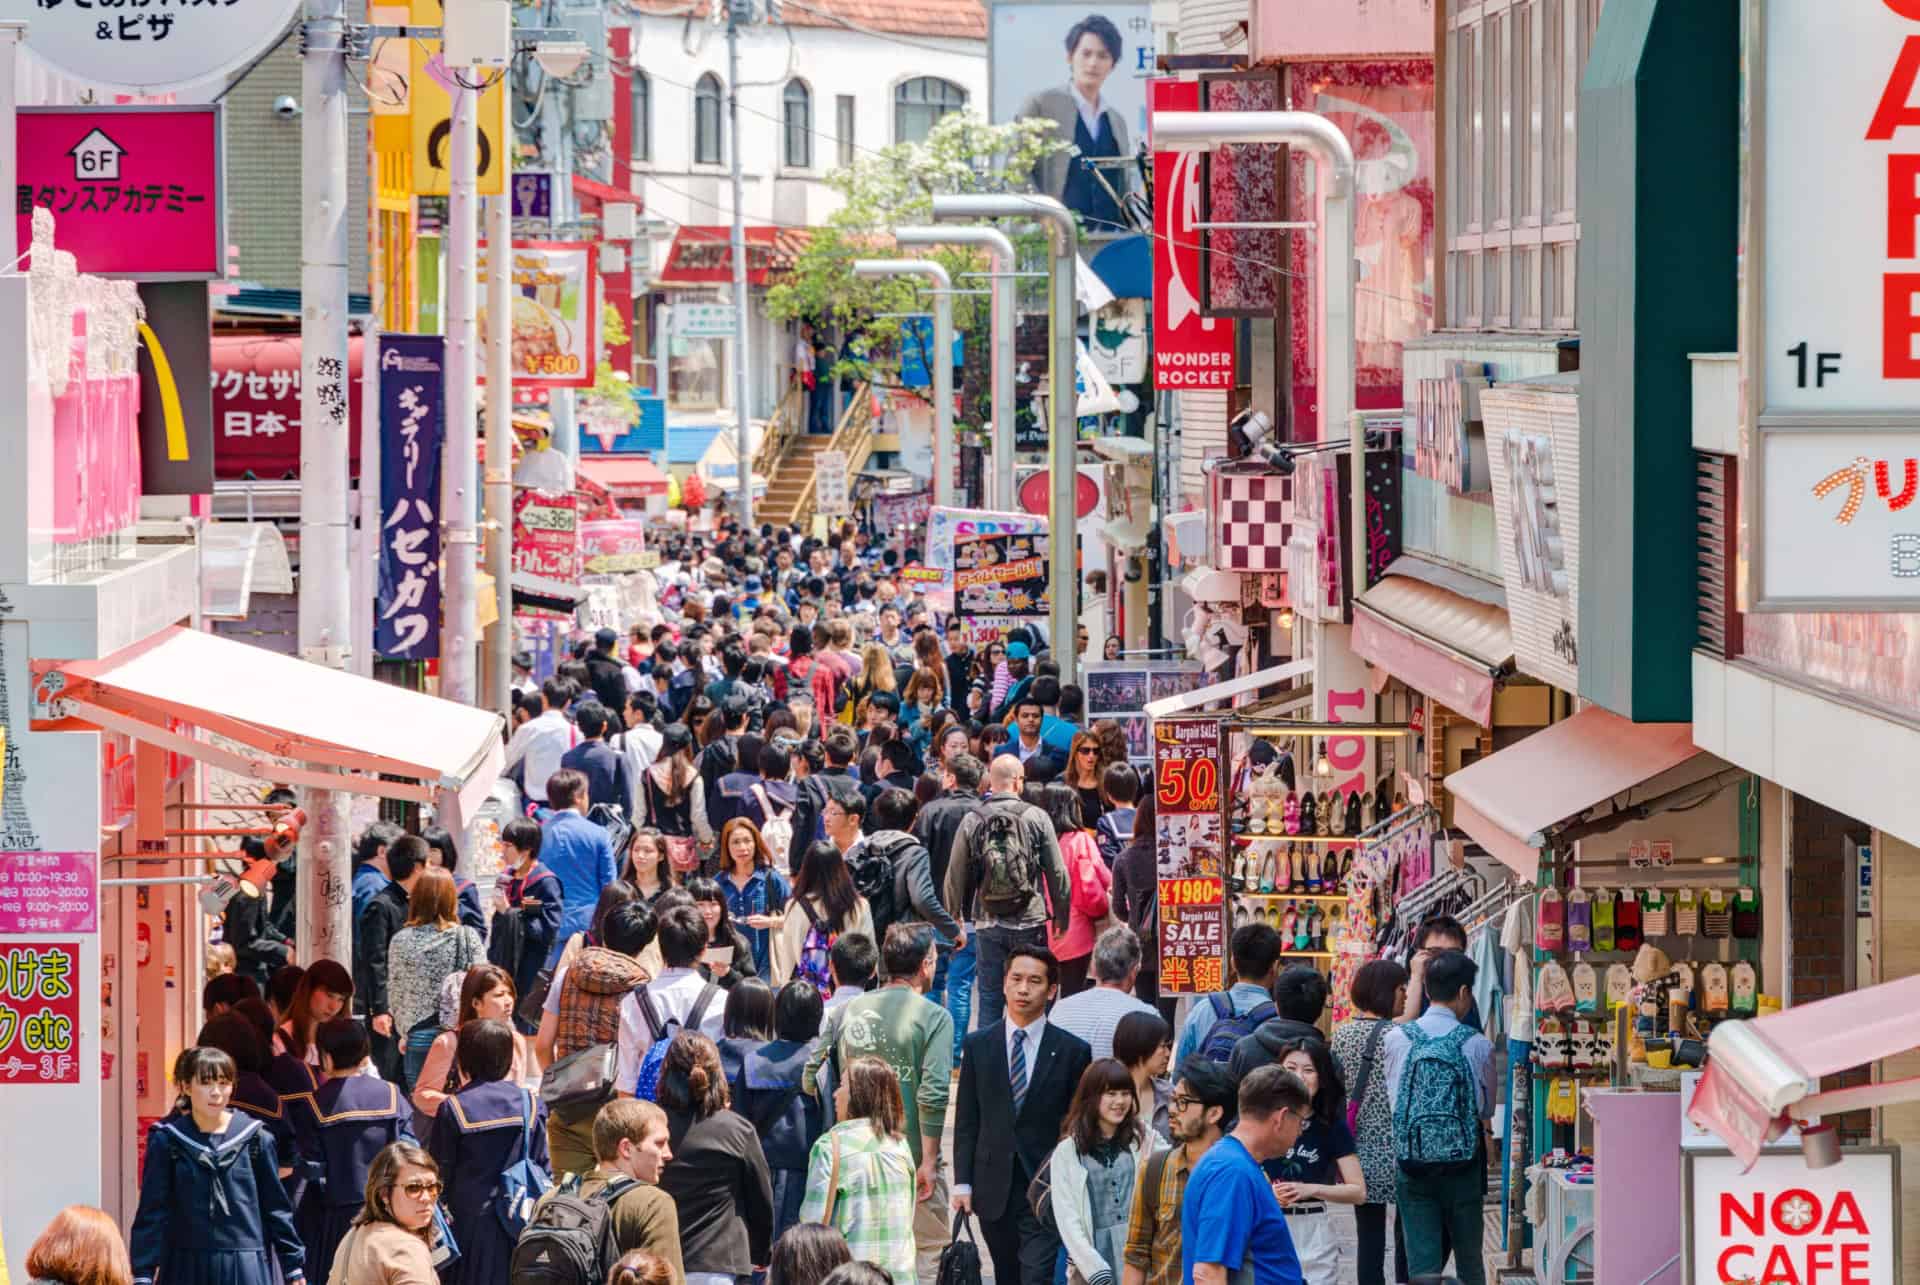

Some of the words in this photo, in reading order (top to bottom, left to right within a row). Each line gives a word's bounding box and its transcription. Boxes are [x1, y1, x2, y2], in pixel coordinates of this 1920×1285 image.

[81, 150, 113, 172] 6F
[1156, 351, 1231, 367] WONDER
[1158, 370, 1231, 385] ROCKET
[1786, 342, 1842, 388] 1F
[1158, 758, 1216, 805] 50
[1165, 923, 1220, 941] SALE
[0, 948, 71, 999] けま
[1160, 957, 1223, 993] 半額
[24, 1007, 71, 1051] etc
[1719, 1187, 1871, 1237] NOA
[1716, 1243, 1871, 1285] CAFE
